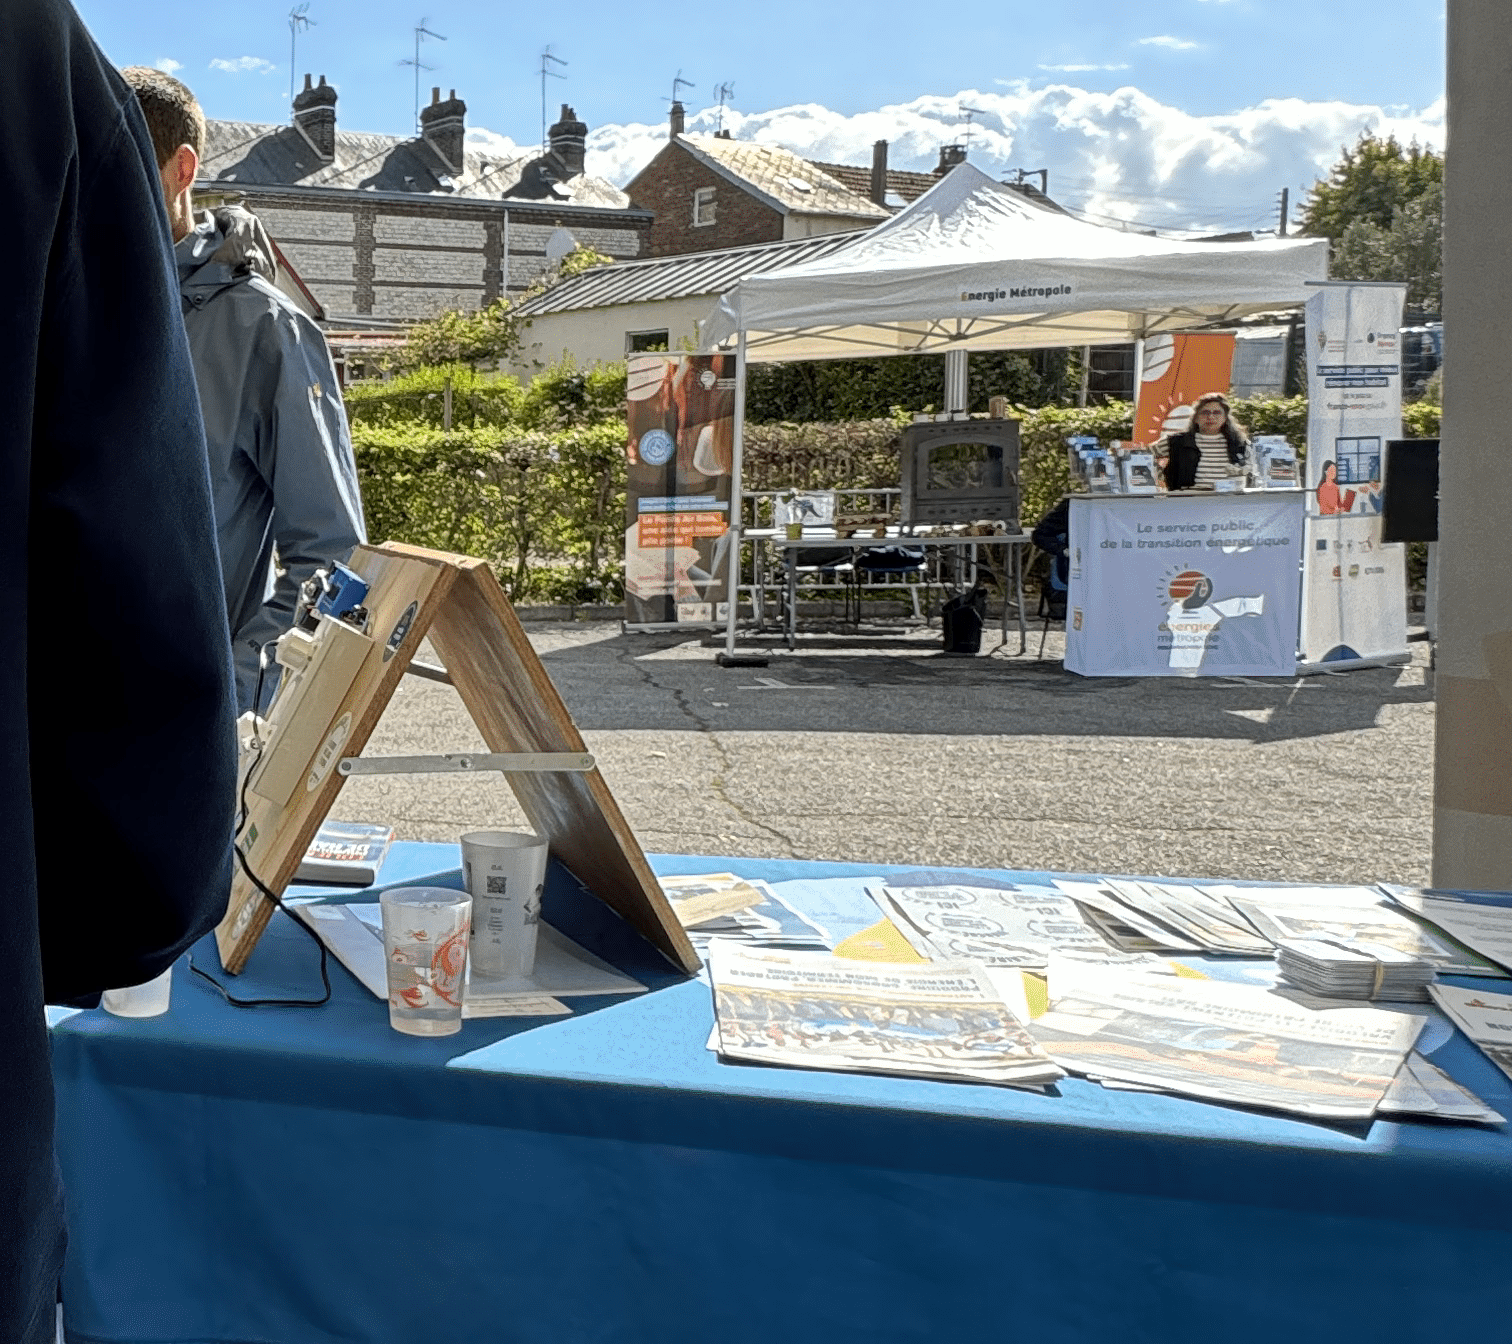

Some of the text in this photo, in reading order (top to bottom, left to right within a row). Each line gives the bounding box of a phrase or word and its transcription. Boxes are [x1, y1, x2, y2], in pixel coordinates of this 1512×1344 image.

[1009, 283, 1072, 299] Métropole
[1136, 519, 1255, 535] Le service public
[1099, 538, 1118, 550] de
[1121, 538, 1133, 549] la
[1136, 537, 1202, 549] transition
